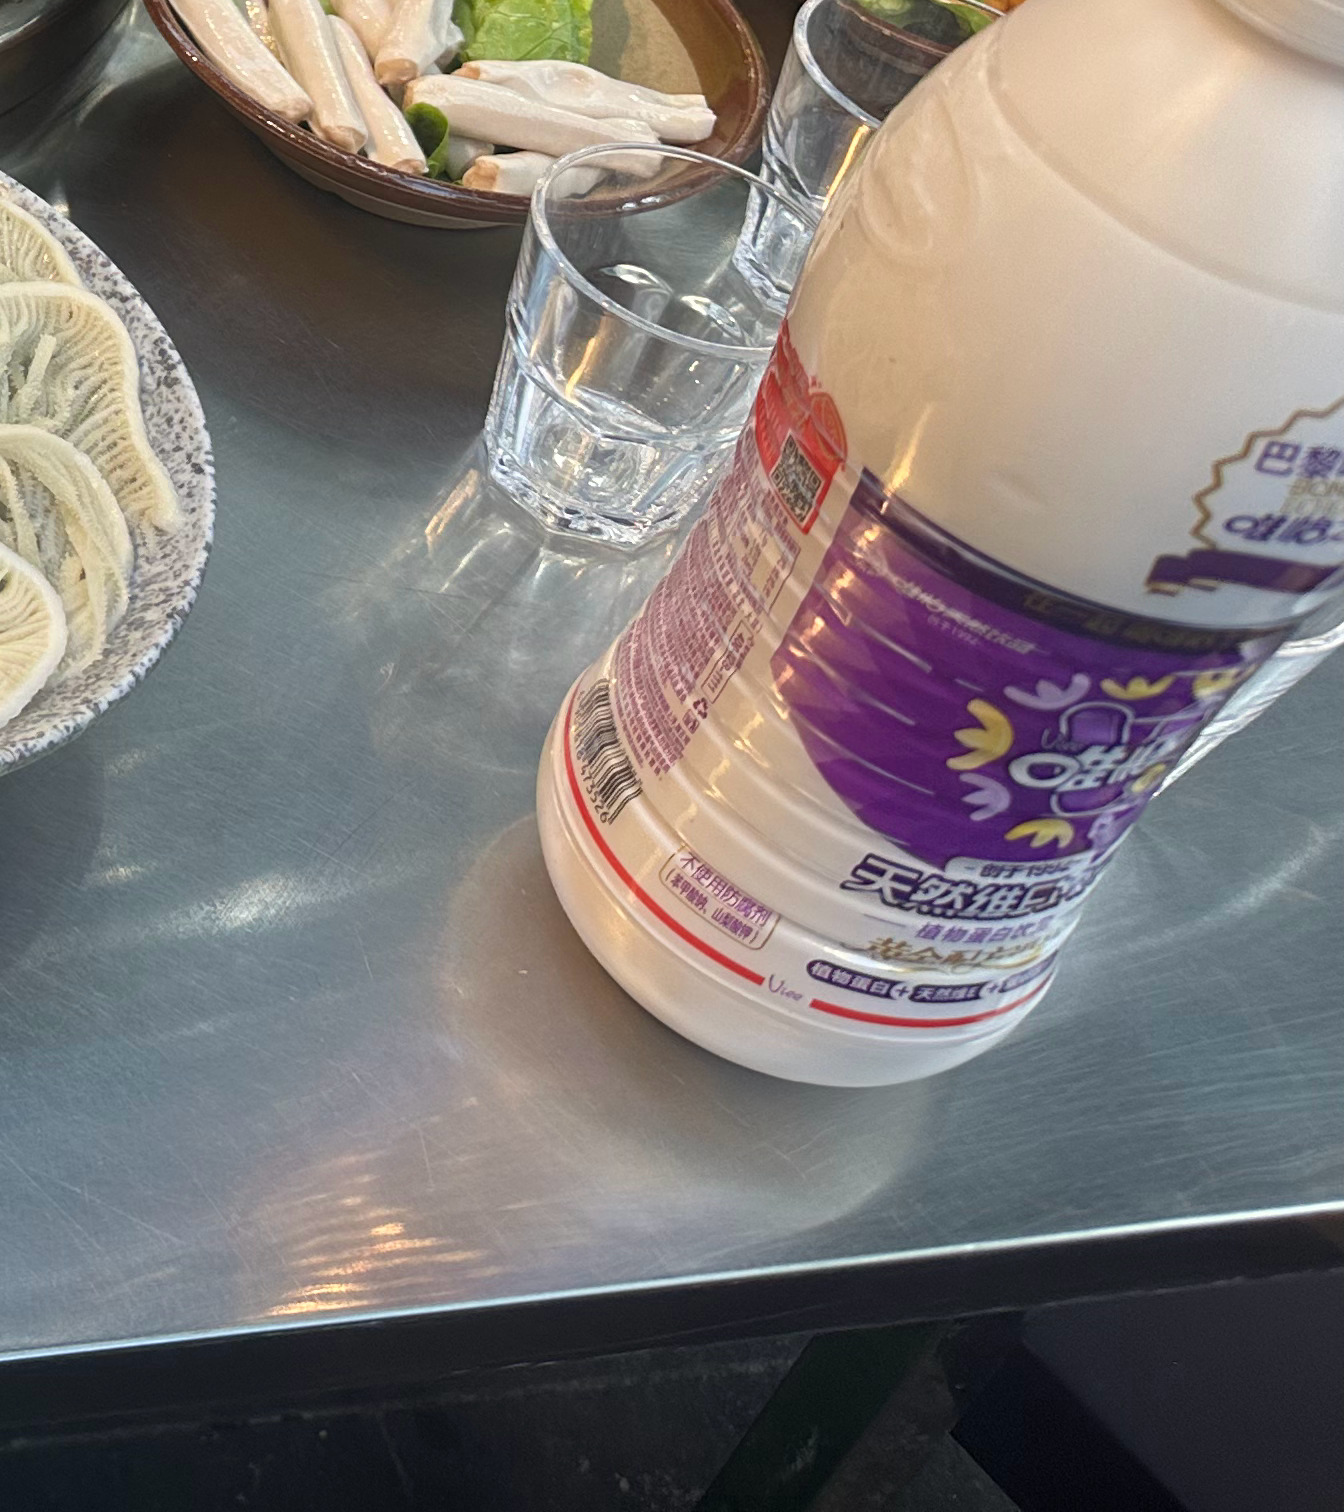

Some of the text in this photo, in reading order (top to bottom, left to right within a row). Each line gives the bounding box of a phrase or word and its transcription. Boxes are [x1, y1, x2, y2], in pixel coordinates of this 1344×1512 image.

[1255, 440, 1344, 478] 巴黎
[679, 851, 772, 927] 不使用防腐剂
